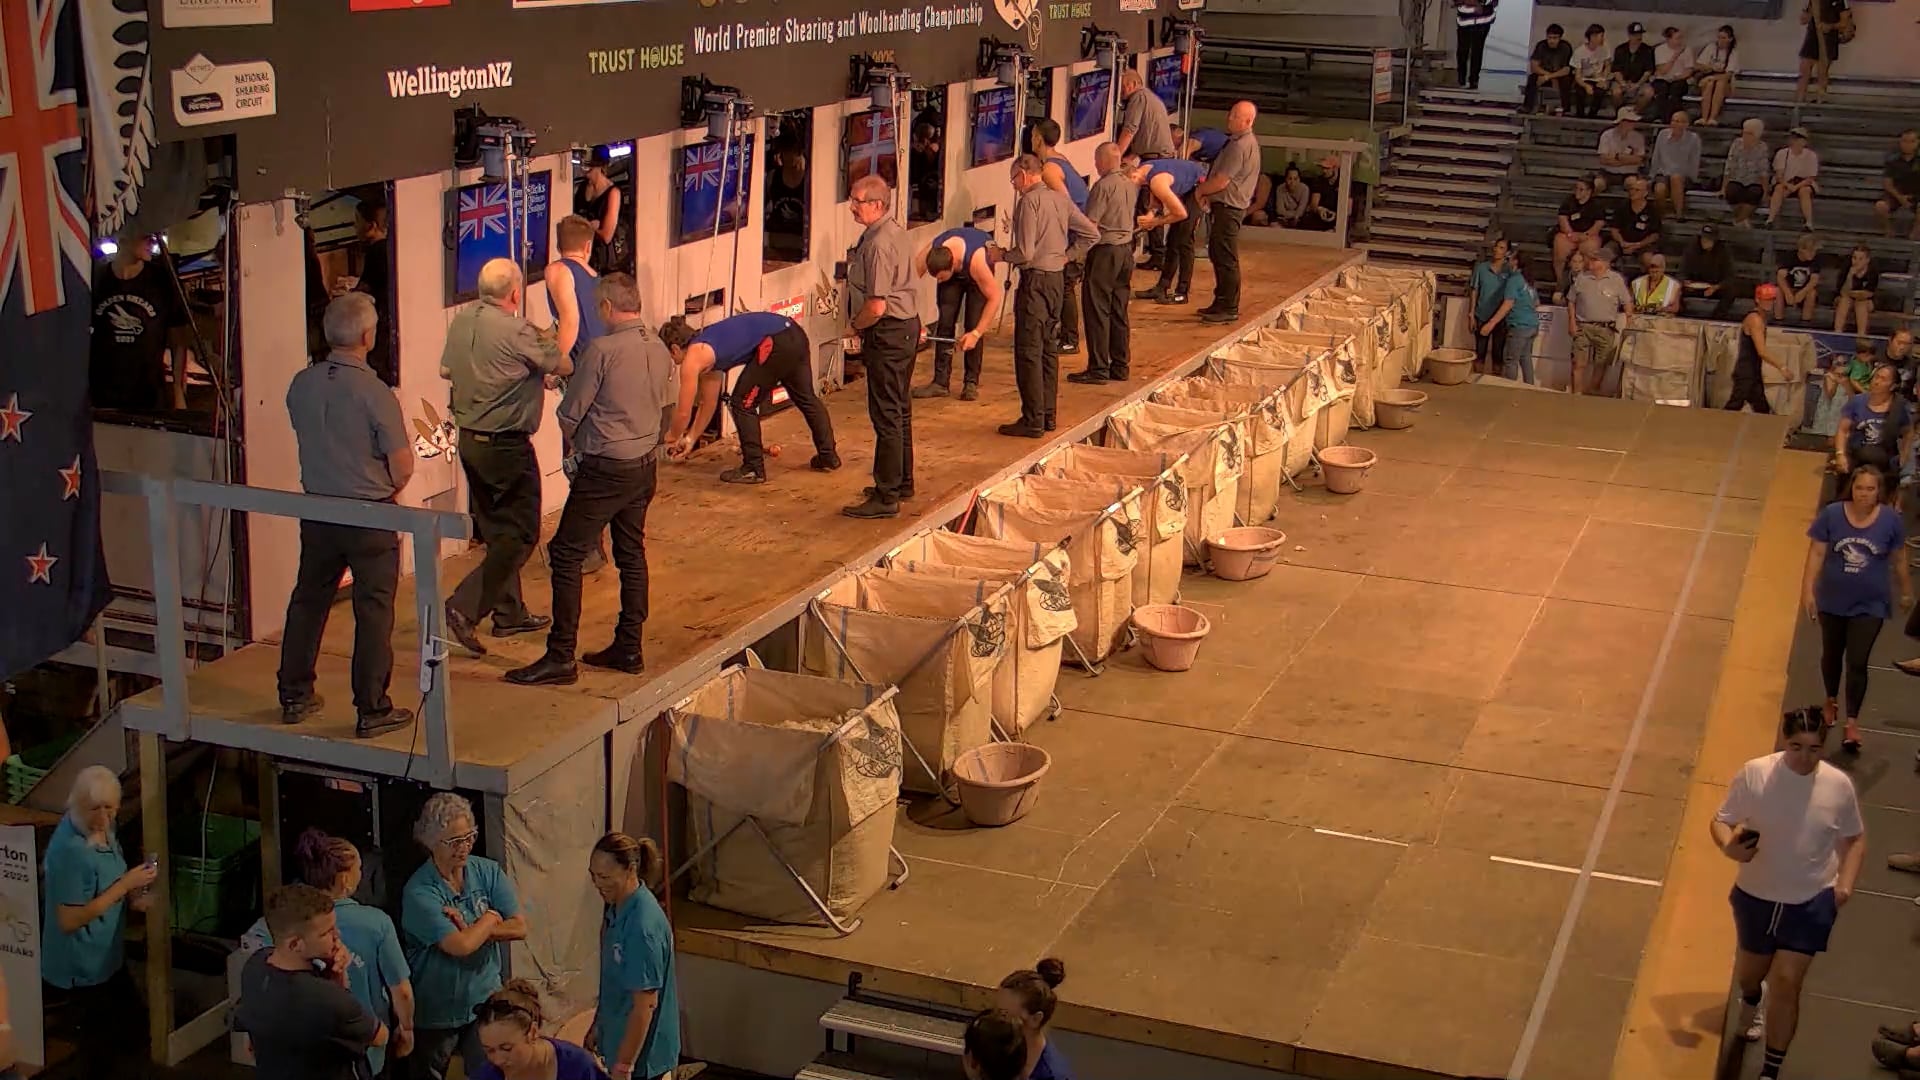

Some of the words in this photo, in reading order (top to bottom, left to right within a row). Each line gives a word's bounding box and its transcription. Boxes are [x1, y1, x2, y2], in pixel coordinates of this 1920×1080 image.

[1049, 4, 1069, 20] TRUST
[1071, 3, 1092, 19] HOUSE
[694, 26, 731, 54] World
[736, 23, 781, 50] Premier
[785, 17, 834, 44] Shearing
[837, 19, 855, 37] and
[859, 7, 921, 33] Woolhandling
[924, 4, 984, 30] Championship
[589, 49, 635, 74] TRUST
[640, 44, 684, 69] HOUSE
[235, 72, 269, 83] NATIONAL
[387, 61, 513, 98] WellingtonNZ
[235, 84, 271, 96] SHEARING
[235, 96, 263, 109] CIRCUIT
[3, 869, 30, 883] 2025
